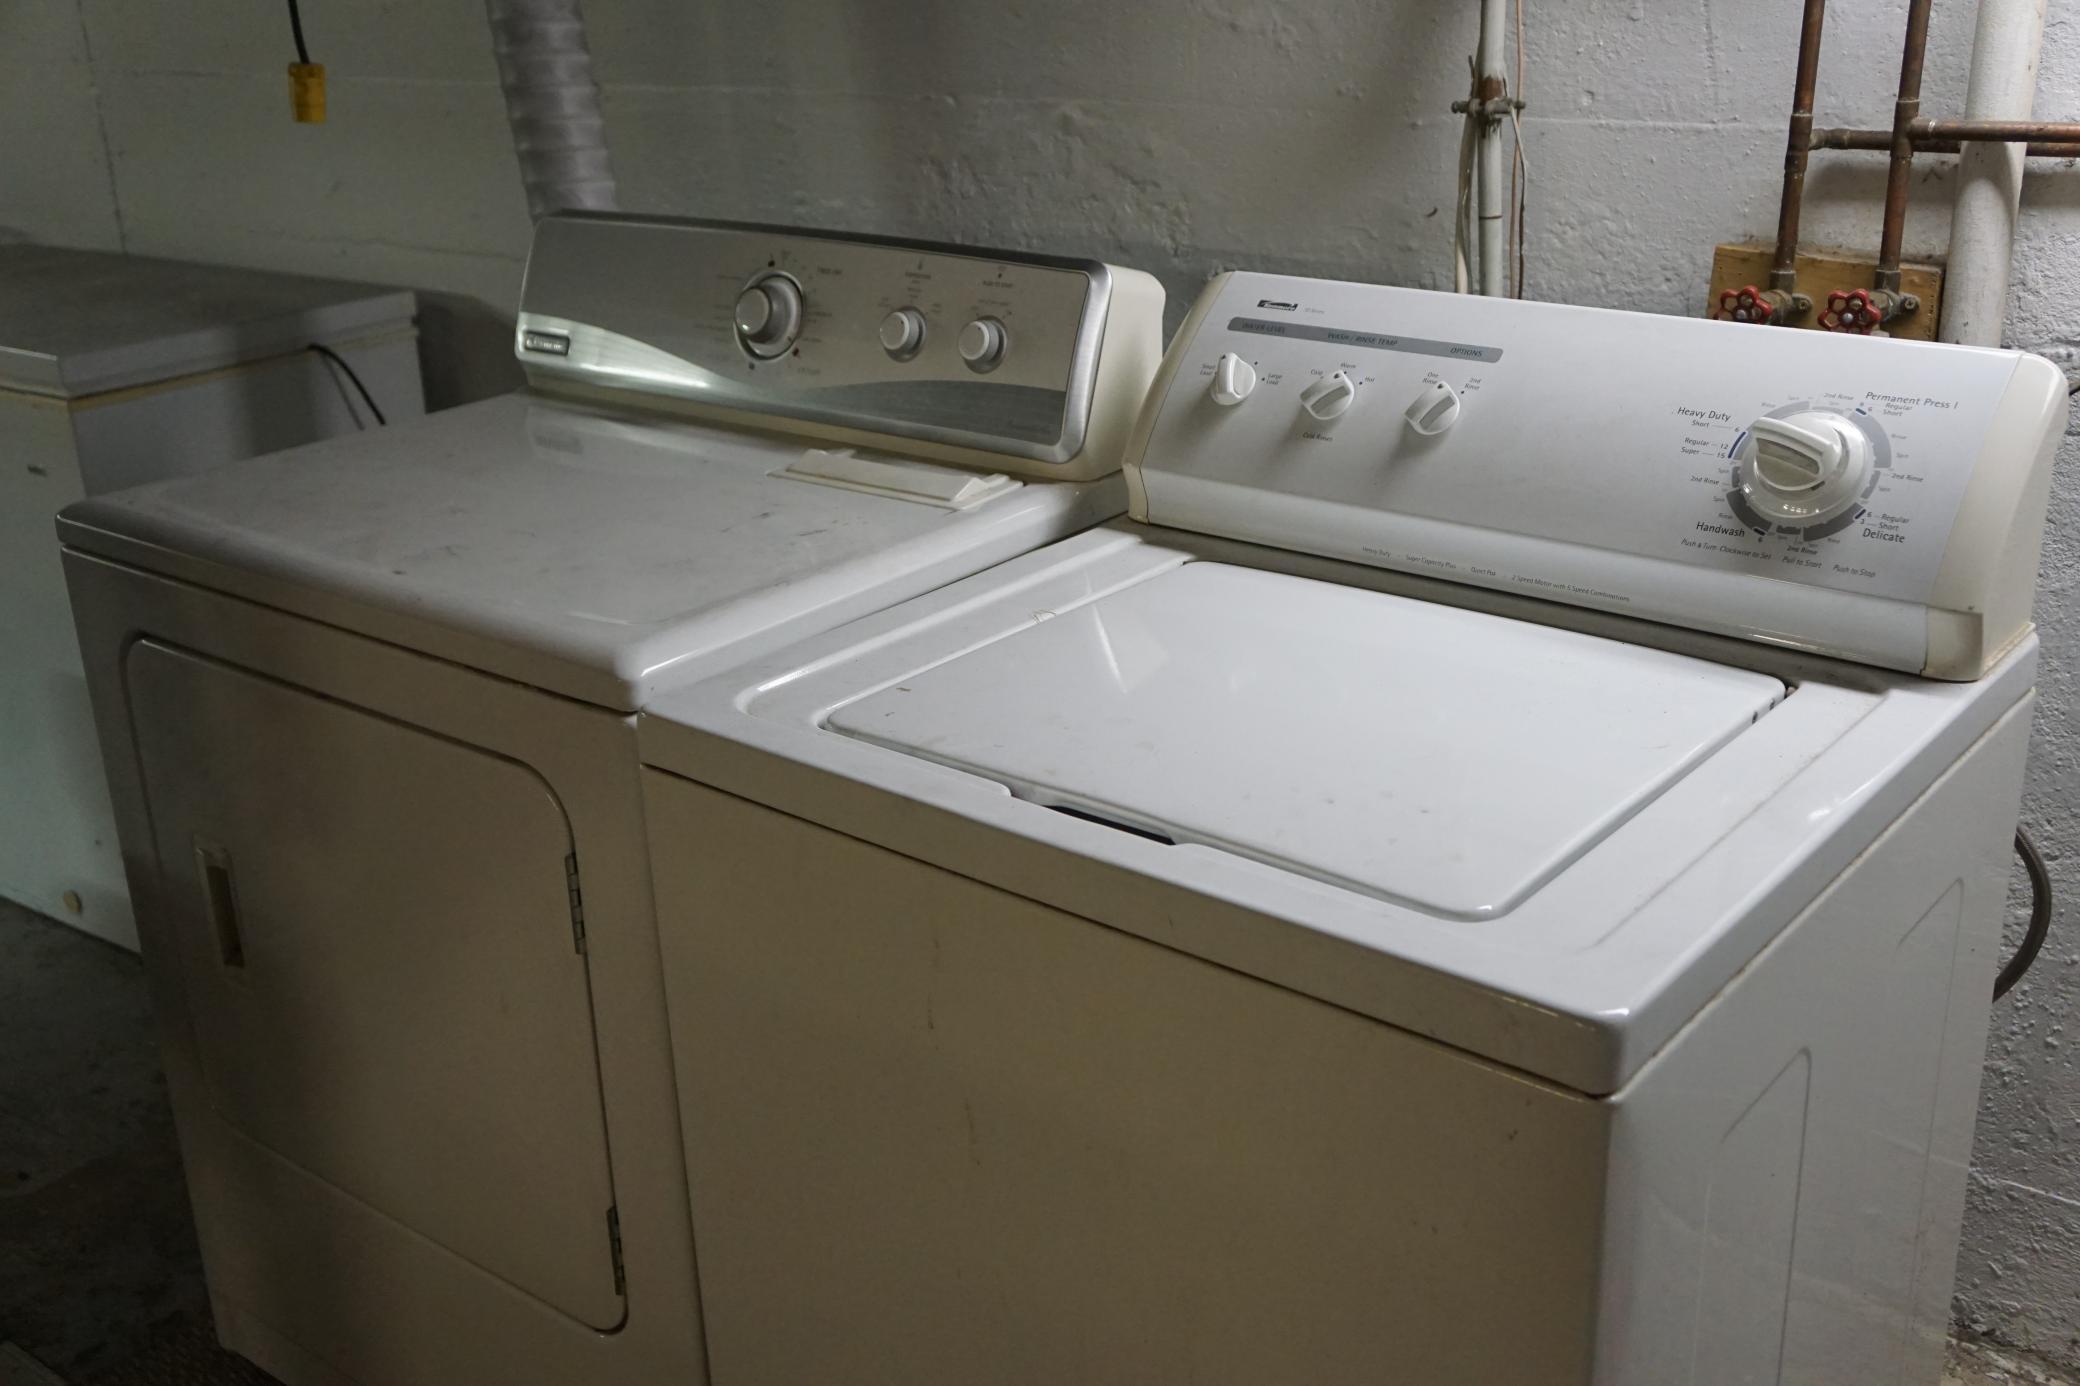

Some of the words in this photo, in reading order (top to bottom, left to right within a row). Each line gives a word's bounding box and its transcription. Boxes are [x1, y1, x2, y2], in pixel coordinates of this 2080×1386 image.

[1377, 338, 1398, 346] TEMP
[1450, 347, 1483, 357] OPTIONS
[1865, 391, 1921, 405] Permanent
[1923, 398, 1950, 409] Press
[1885, 402, 1913, 411] Regular
[1677, 406, 1706, 419] Heavy
[1708, 410, 1731, 422] Duty
[1883, 409, 1903, 417] Short
[1691, 420, 1710, 428] Short
[1684, 437, 1709, 447] Regular
[1680, 446, 1700, 455] Super
[1881, 513, 1910, 524] Regular
[1696, 521, 1745, 537] Handwash
[1879, 522, 1899, 531] Short
[1862, 528, 1905, 543] Delicate
[1680, 538, 1697, 547] Push
[1572, 585, 1590, 594] Speed
